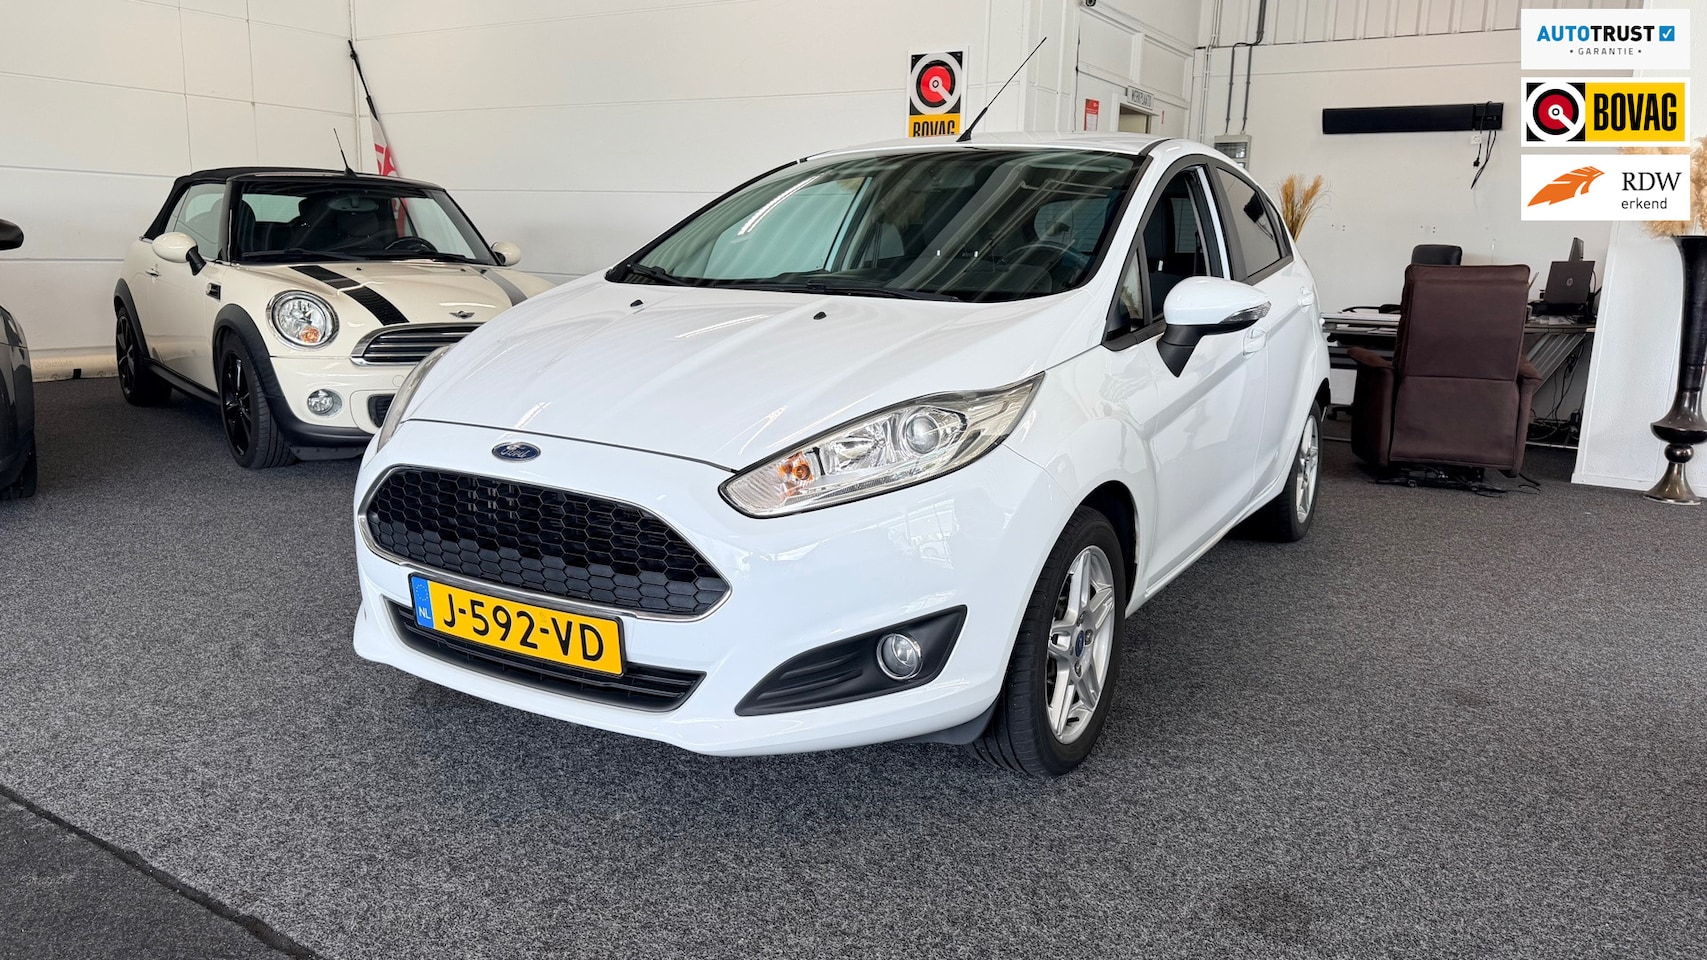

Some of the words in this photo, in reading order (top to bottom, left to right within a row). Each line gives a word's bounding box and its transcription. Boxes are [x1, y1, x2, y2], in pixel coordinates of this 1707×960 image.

[913, 120, 955, 137] BOVAG
[418, 606, 431, 620] NL
[443, 593, 604, 662] J-592-VD
